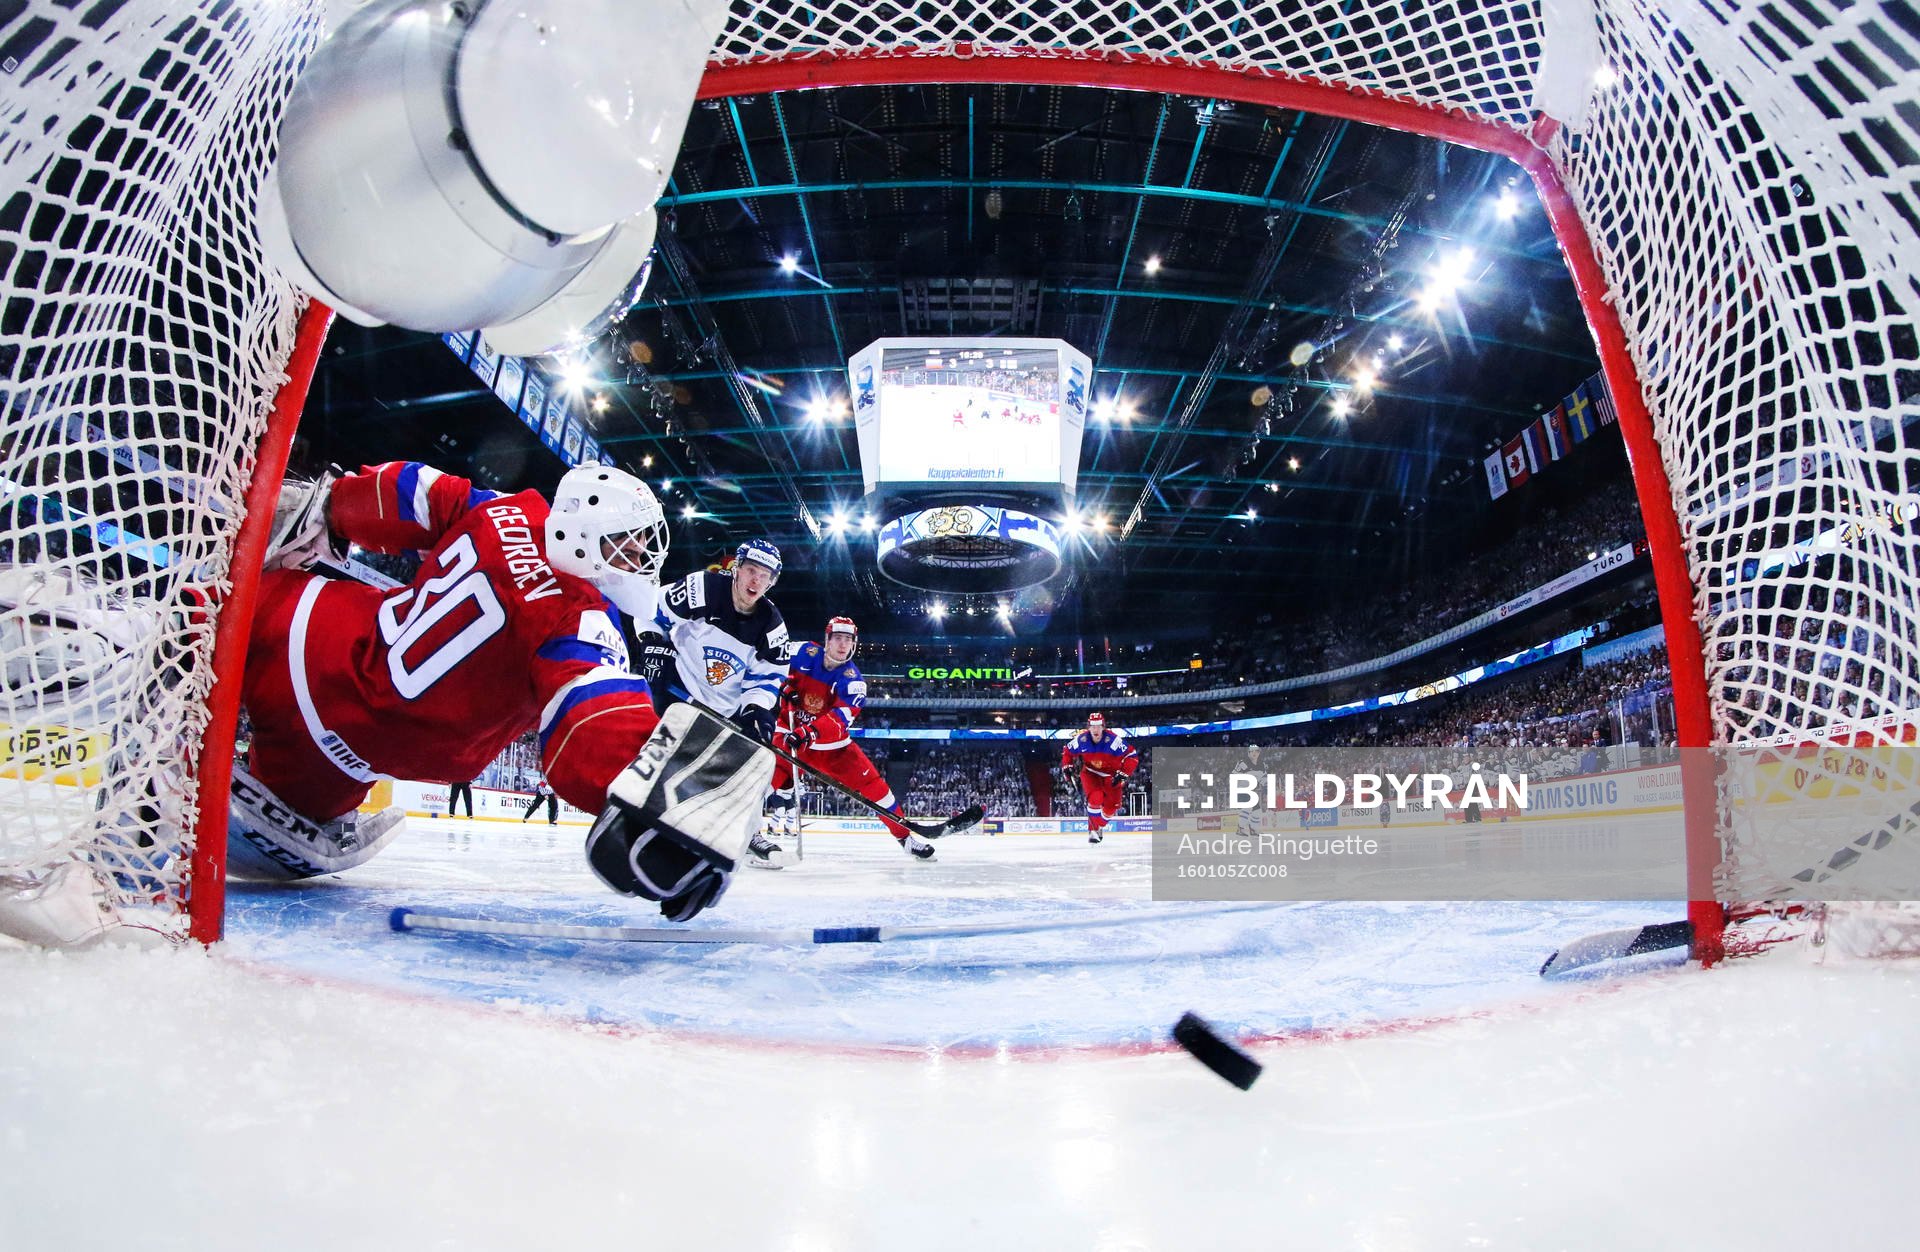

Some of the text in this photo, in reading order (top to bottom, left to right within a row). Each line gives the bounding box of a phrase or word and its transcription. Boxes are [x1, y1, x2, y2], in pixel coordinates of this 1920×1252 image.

[1592, 552, 1623, 573] TURO
[668, 581, 687, 606] 19
[378, 533, 506, 699] 30
[706, 648, 743, 671] SUOMI
[908, 667, 1011, 680] GIGANTTI
[329, 743, 367, 772] IIHF
[627, 723, 677, 781] CCM
[231, 776, 319, 842] CCM
[1525, 780, 1617, 811] SAMSUNG
[1312, 809, 1332, 825] pepsi
[1350, 808, 1373, 816] TISSOT
[242, 829, 324, 878] CCM
